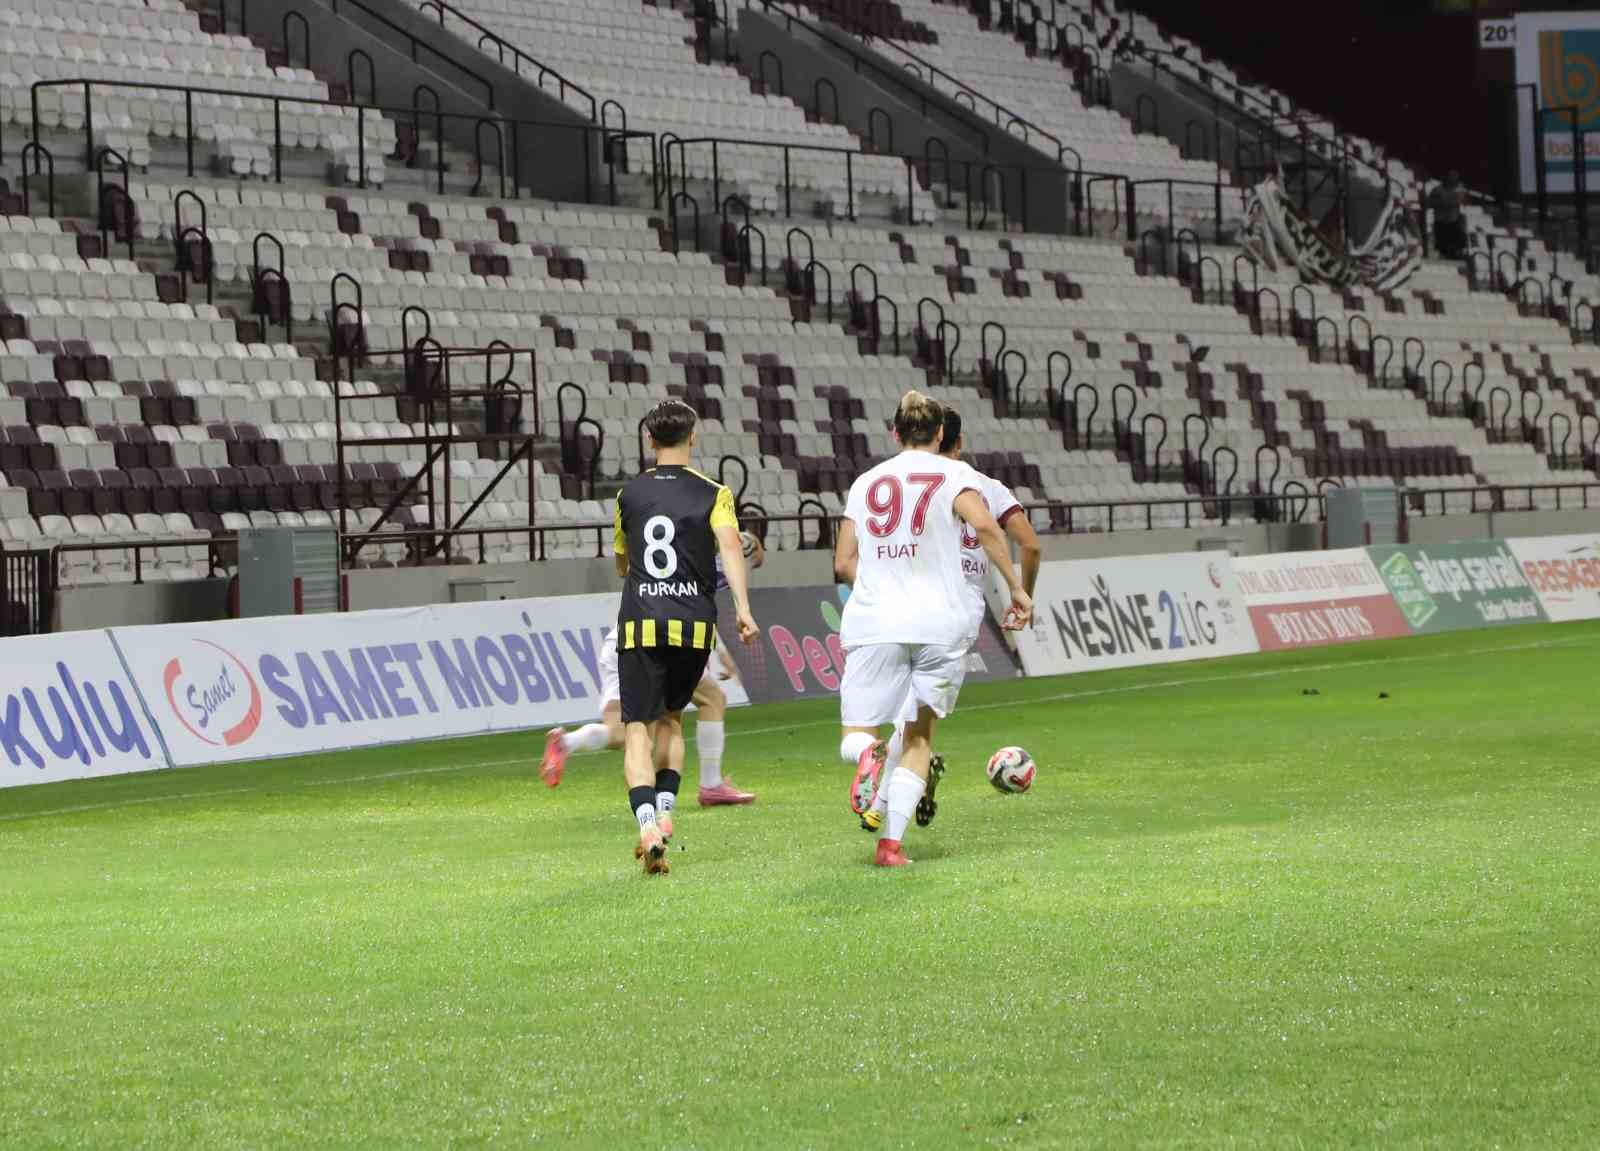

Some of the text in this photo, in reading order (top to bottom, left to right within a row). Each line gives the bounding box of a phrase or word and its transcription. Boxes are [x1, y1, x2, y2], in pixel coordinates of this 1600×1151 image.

[866, 472, 946, 537] 97
[644, 515, 678, 579] 8
[877, 543, 918, 560] FUAT
[638, 581, 699, 598] FURKAN
[1051, 574, 1163, 660] NESİNE
[186, 662, 236, 728] Samet
[258, 610, 612, 728] SAMET MOBİLY
